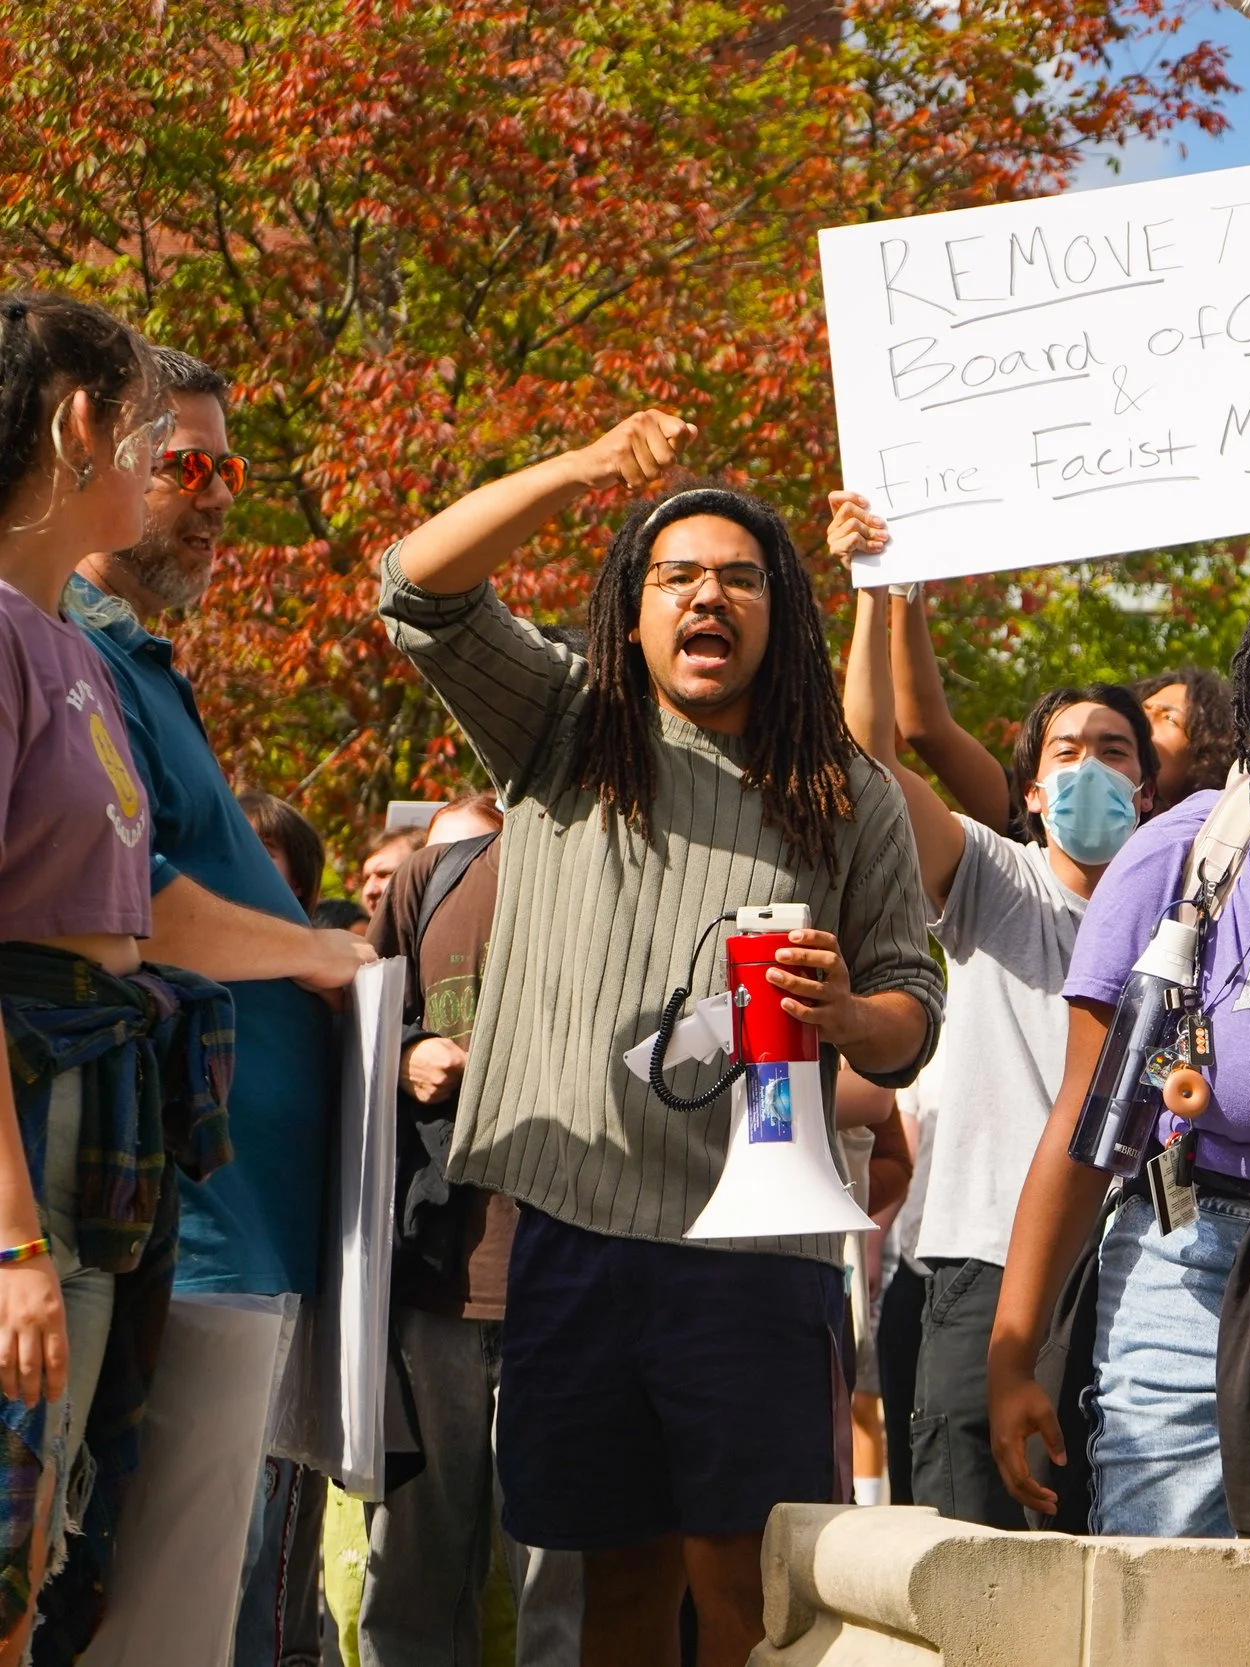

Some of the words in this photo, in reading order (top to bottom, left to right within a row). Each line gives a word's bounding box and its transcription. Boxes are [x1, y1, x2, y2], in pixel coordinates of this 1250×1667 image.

[880, 218, 1185, 325] REMOVE
[888, 331, 1105, 402] Board
[1147, 304, 1224, 357] of
[1112, 365, 1158, 416] &
[876, 440, 982, 509] Fire
[1029, 420, 1199, 489] Facist
